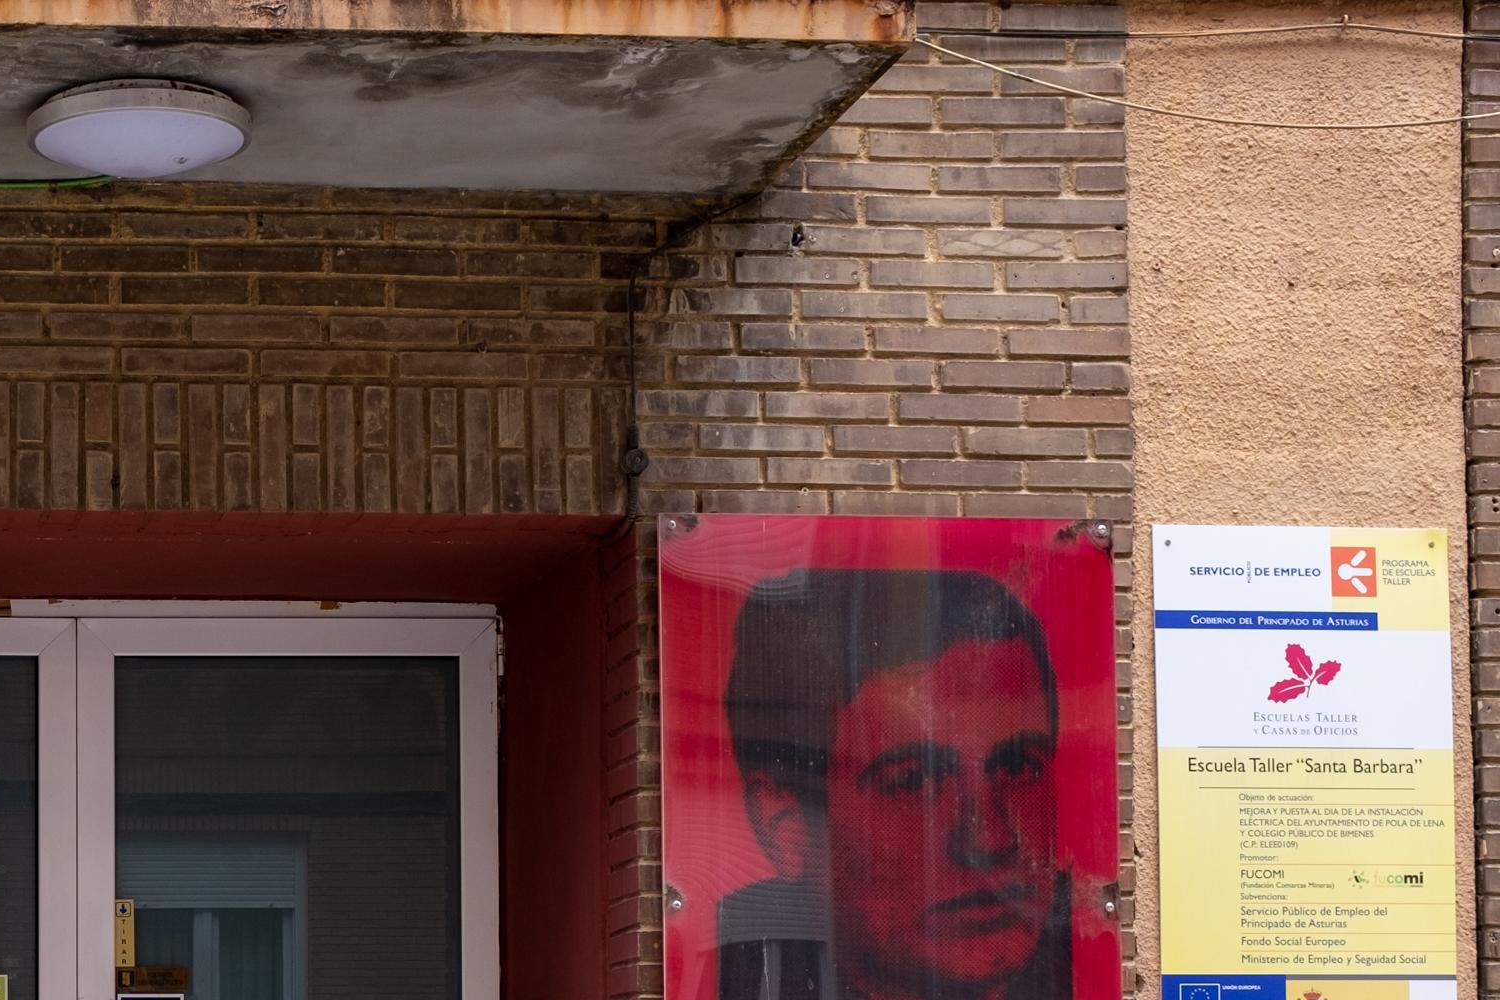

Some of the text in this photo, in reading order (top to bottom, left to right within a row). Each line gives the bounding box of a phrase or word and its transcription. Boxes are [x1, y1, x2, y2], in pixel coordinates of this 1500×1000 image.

[1382, 560, 1429, 568] PROGRAMA
[1190, 566, 1322, 578] SERVICIO DE EMPLEO
[1395, 569, 1436, 577] ESCUELAS
[1383, 577, 1412, 585] TALLER
[1190, 614, 1369, 627] GOBIERNO DEL PRINCIPADO DE ASTURIAS
[1253, 712, 1358, 722] ESCUELAS TALLER
[1262, 725, 1298, 735] CASAS
[1314, 726, 1358, 736] OFICIOS
[1188, 757, 1246, 773] Escuela
[1249, 757, 1293, 773] Taller
[1238, 794, 1265, 802] Objeto
[1267, 794, 1276, 802] de
[1240, 808, 1272, 817] MEJORA
[1272, 808, 1278, 816] Y
[1280, 808, 1310, 816] PUESTA
[1311, 808, 1322, 816] AL
[1341, 809, 1353, 817] DE
[1355, 809, 1366, 817] LA
[1248, 830, 1286, 838] COLEGIO
[1326, 830, 1338, 838] DE
[1340, 830, 1374, 838] BIMENES
[1240, 870, 1284, 879] FUCOMI
[1240, 906, 1388, 918] Servicio Público de Empleo del
[1241, 918, 1347, 930] Principado de Asturias
[120, 919, 128, 965] TIRAR
[1242, 936, 1346, 948] Fondo Social Europeo
[1242, 954, 1290, 964] Ministerio
[1292, 954, 1304, 964] de
[1308, 954, 1344, 966] Empleo
[1346, 958, 1352, 966] y
[1399, 954, 1427, 964] Social
